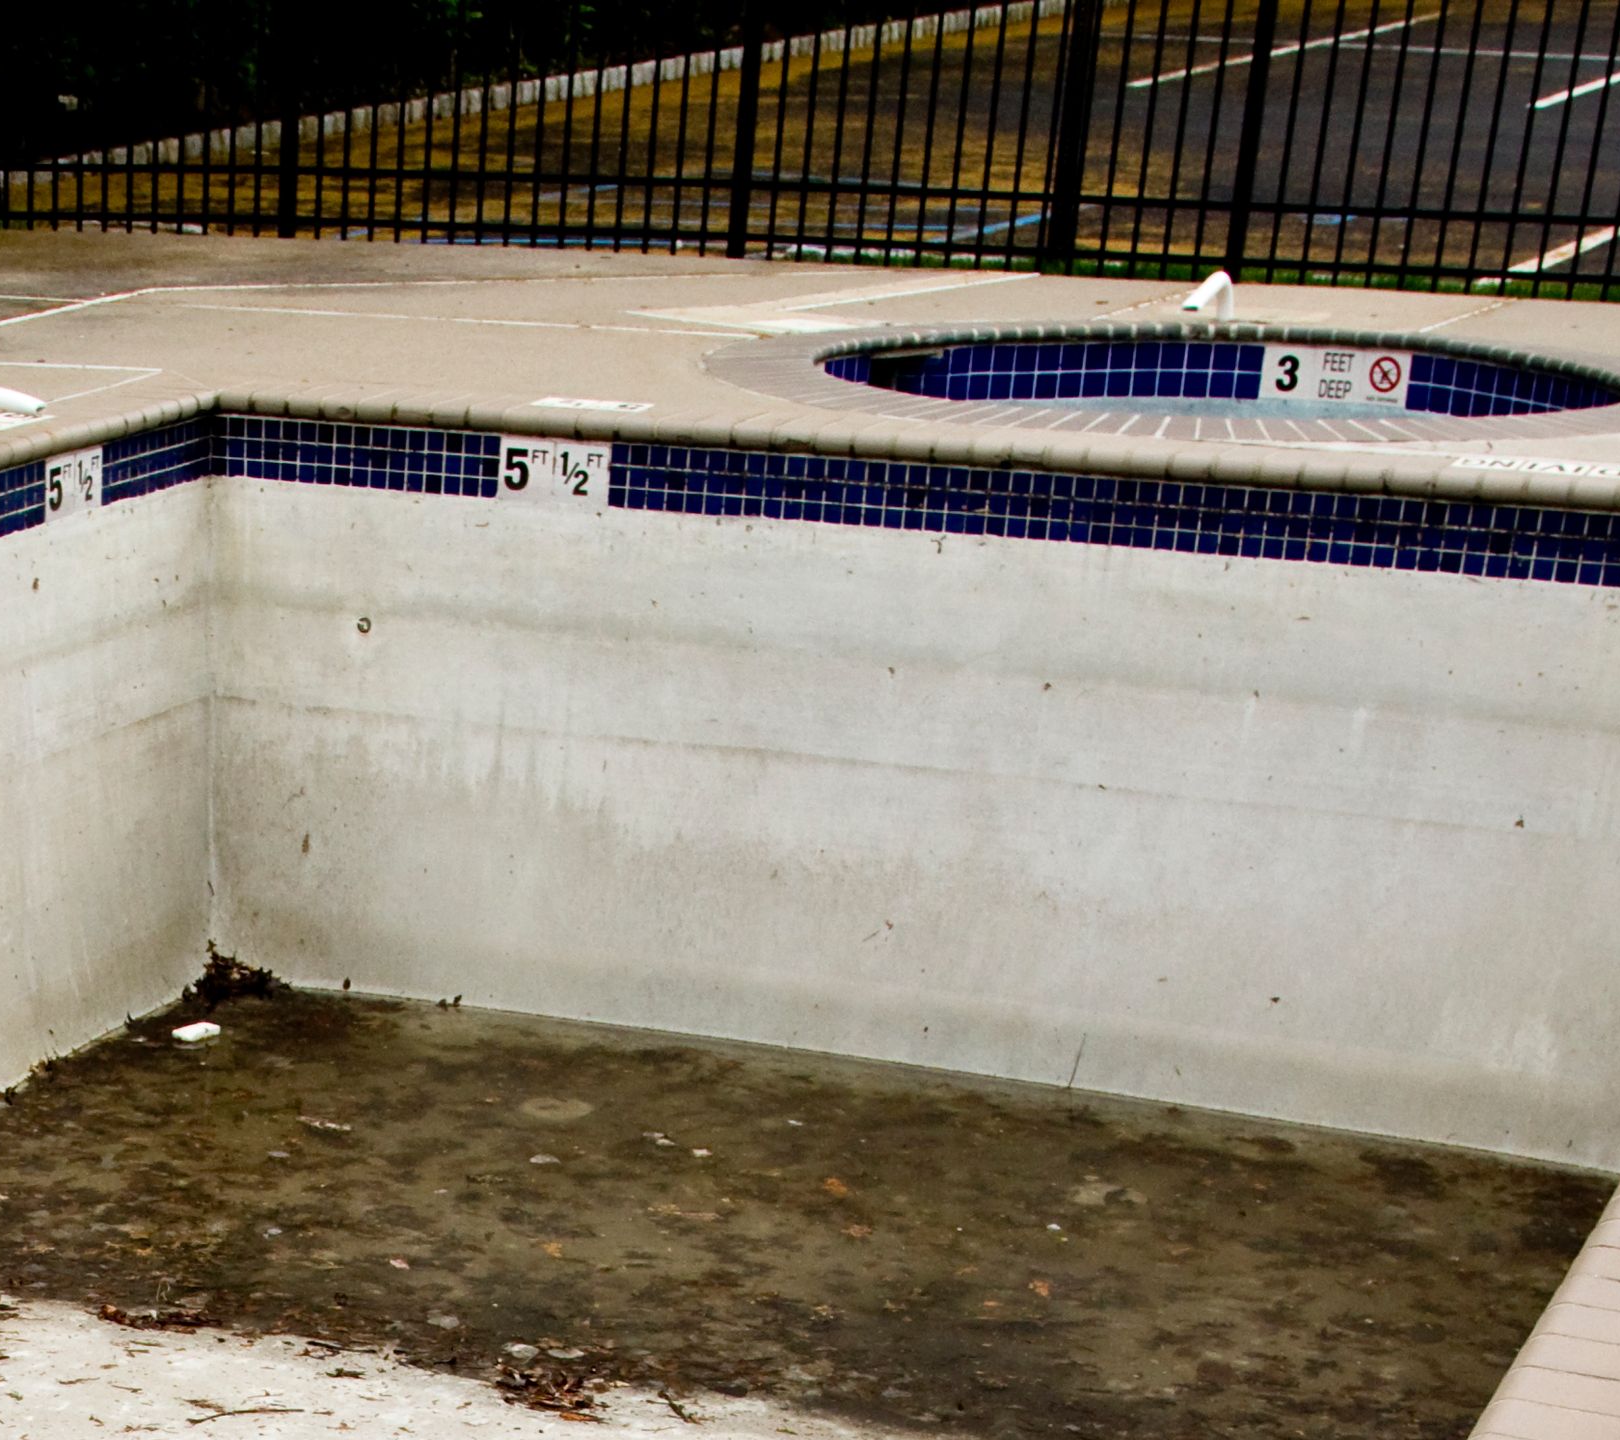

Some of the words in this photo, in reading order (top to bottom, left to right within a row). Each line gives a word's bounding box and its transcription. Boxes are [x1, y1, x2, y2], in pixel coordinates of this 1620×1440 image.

[1275, 355, 1300, 392] 3
[1323, 352, 1355, 373] FEET
[1318, 379, 1352, 399] DEEP
[49, 466, 63, 512] 5
[504, 447, 530, 491] 5
